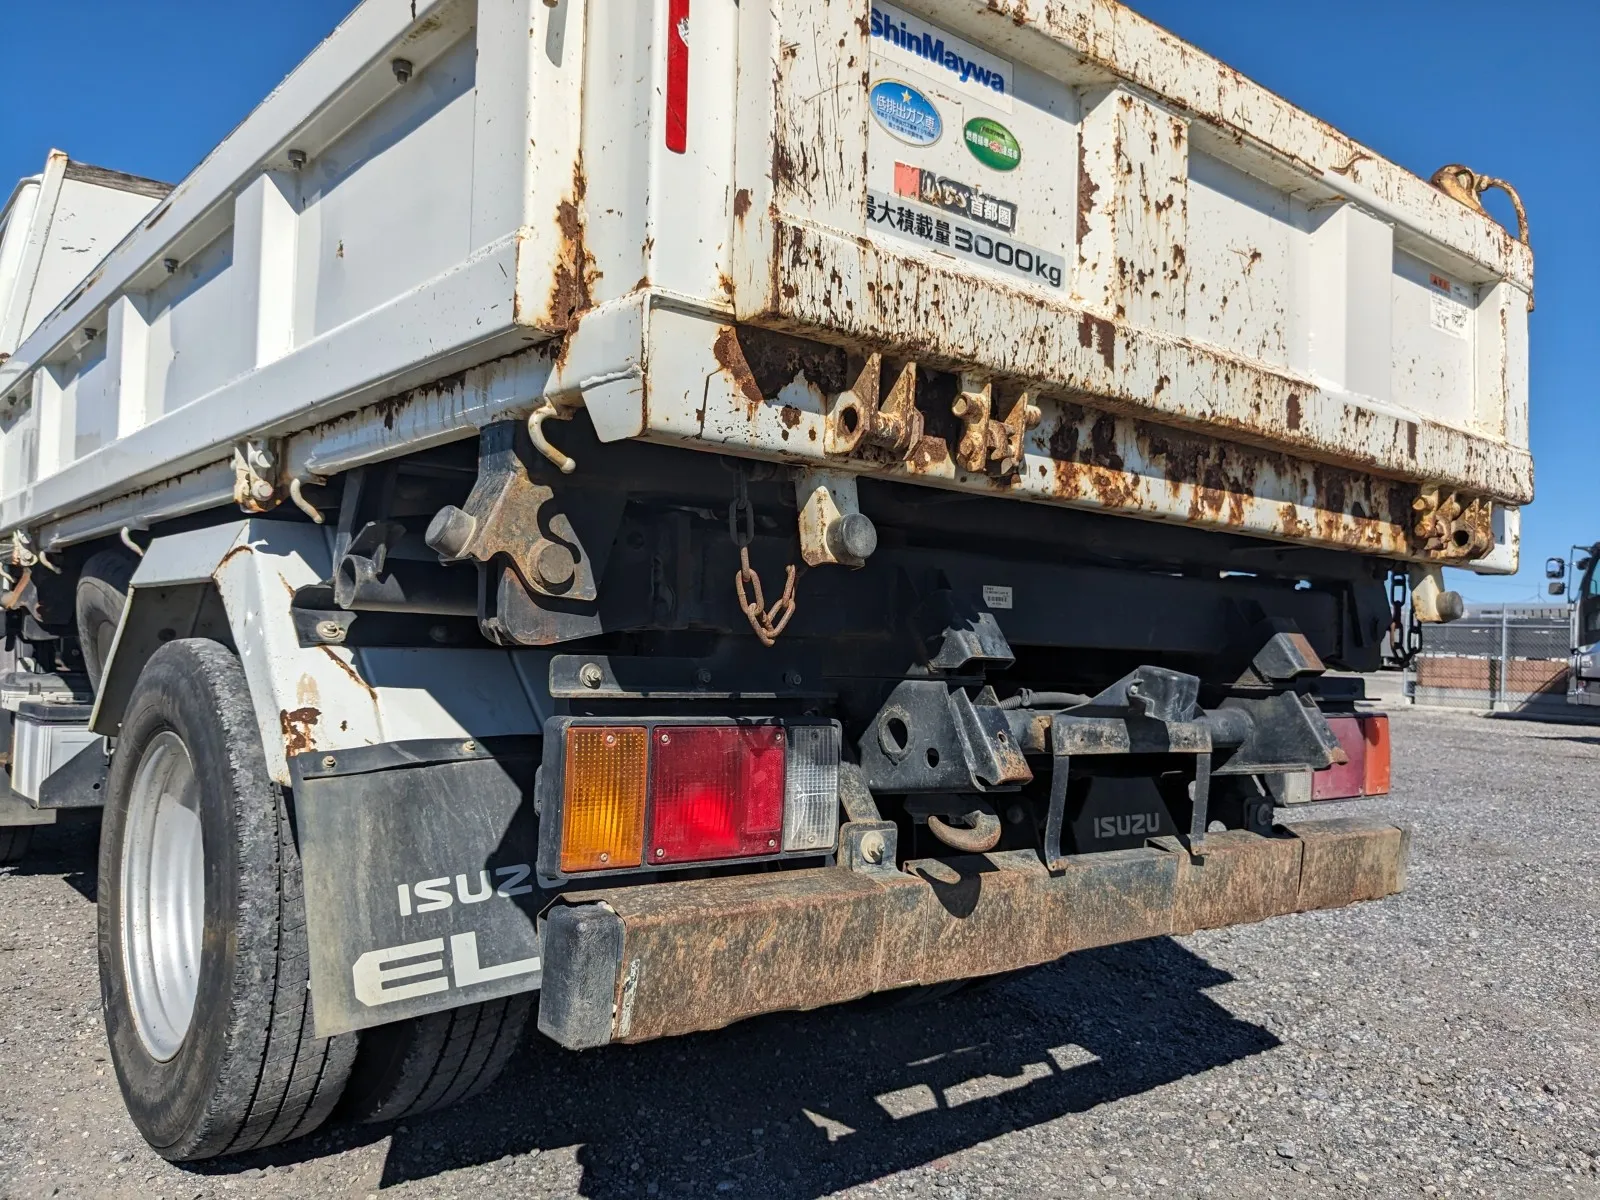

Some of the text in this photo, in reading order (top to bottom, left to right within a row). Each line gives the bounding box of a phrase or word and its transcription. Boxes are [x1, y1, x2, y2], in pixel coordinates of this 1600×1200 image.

[871, 7, 1005, 94] ShinMaywa
[954, 226, 1062, 288] 3000kg
[1093, 812, 1160, 839] ISUZU
